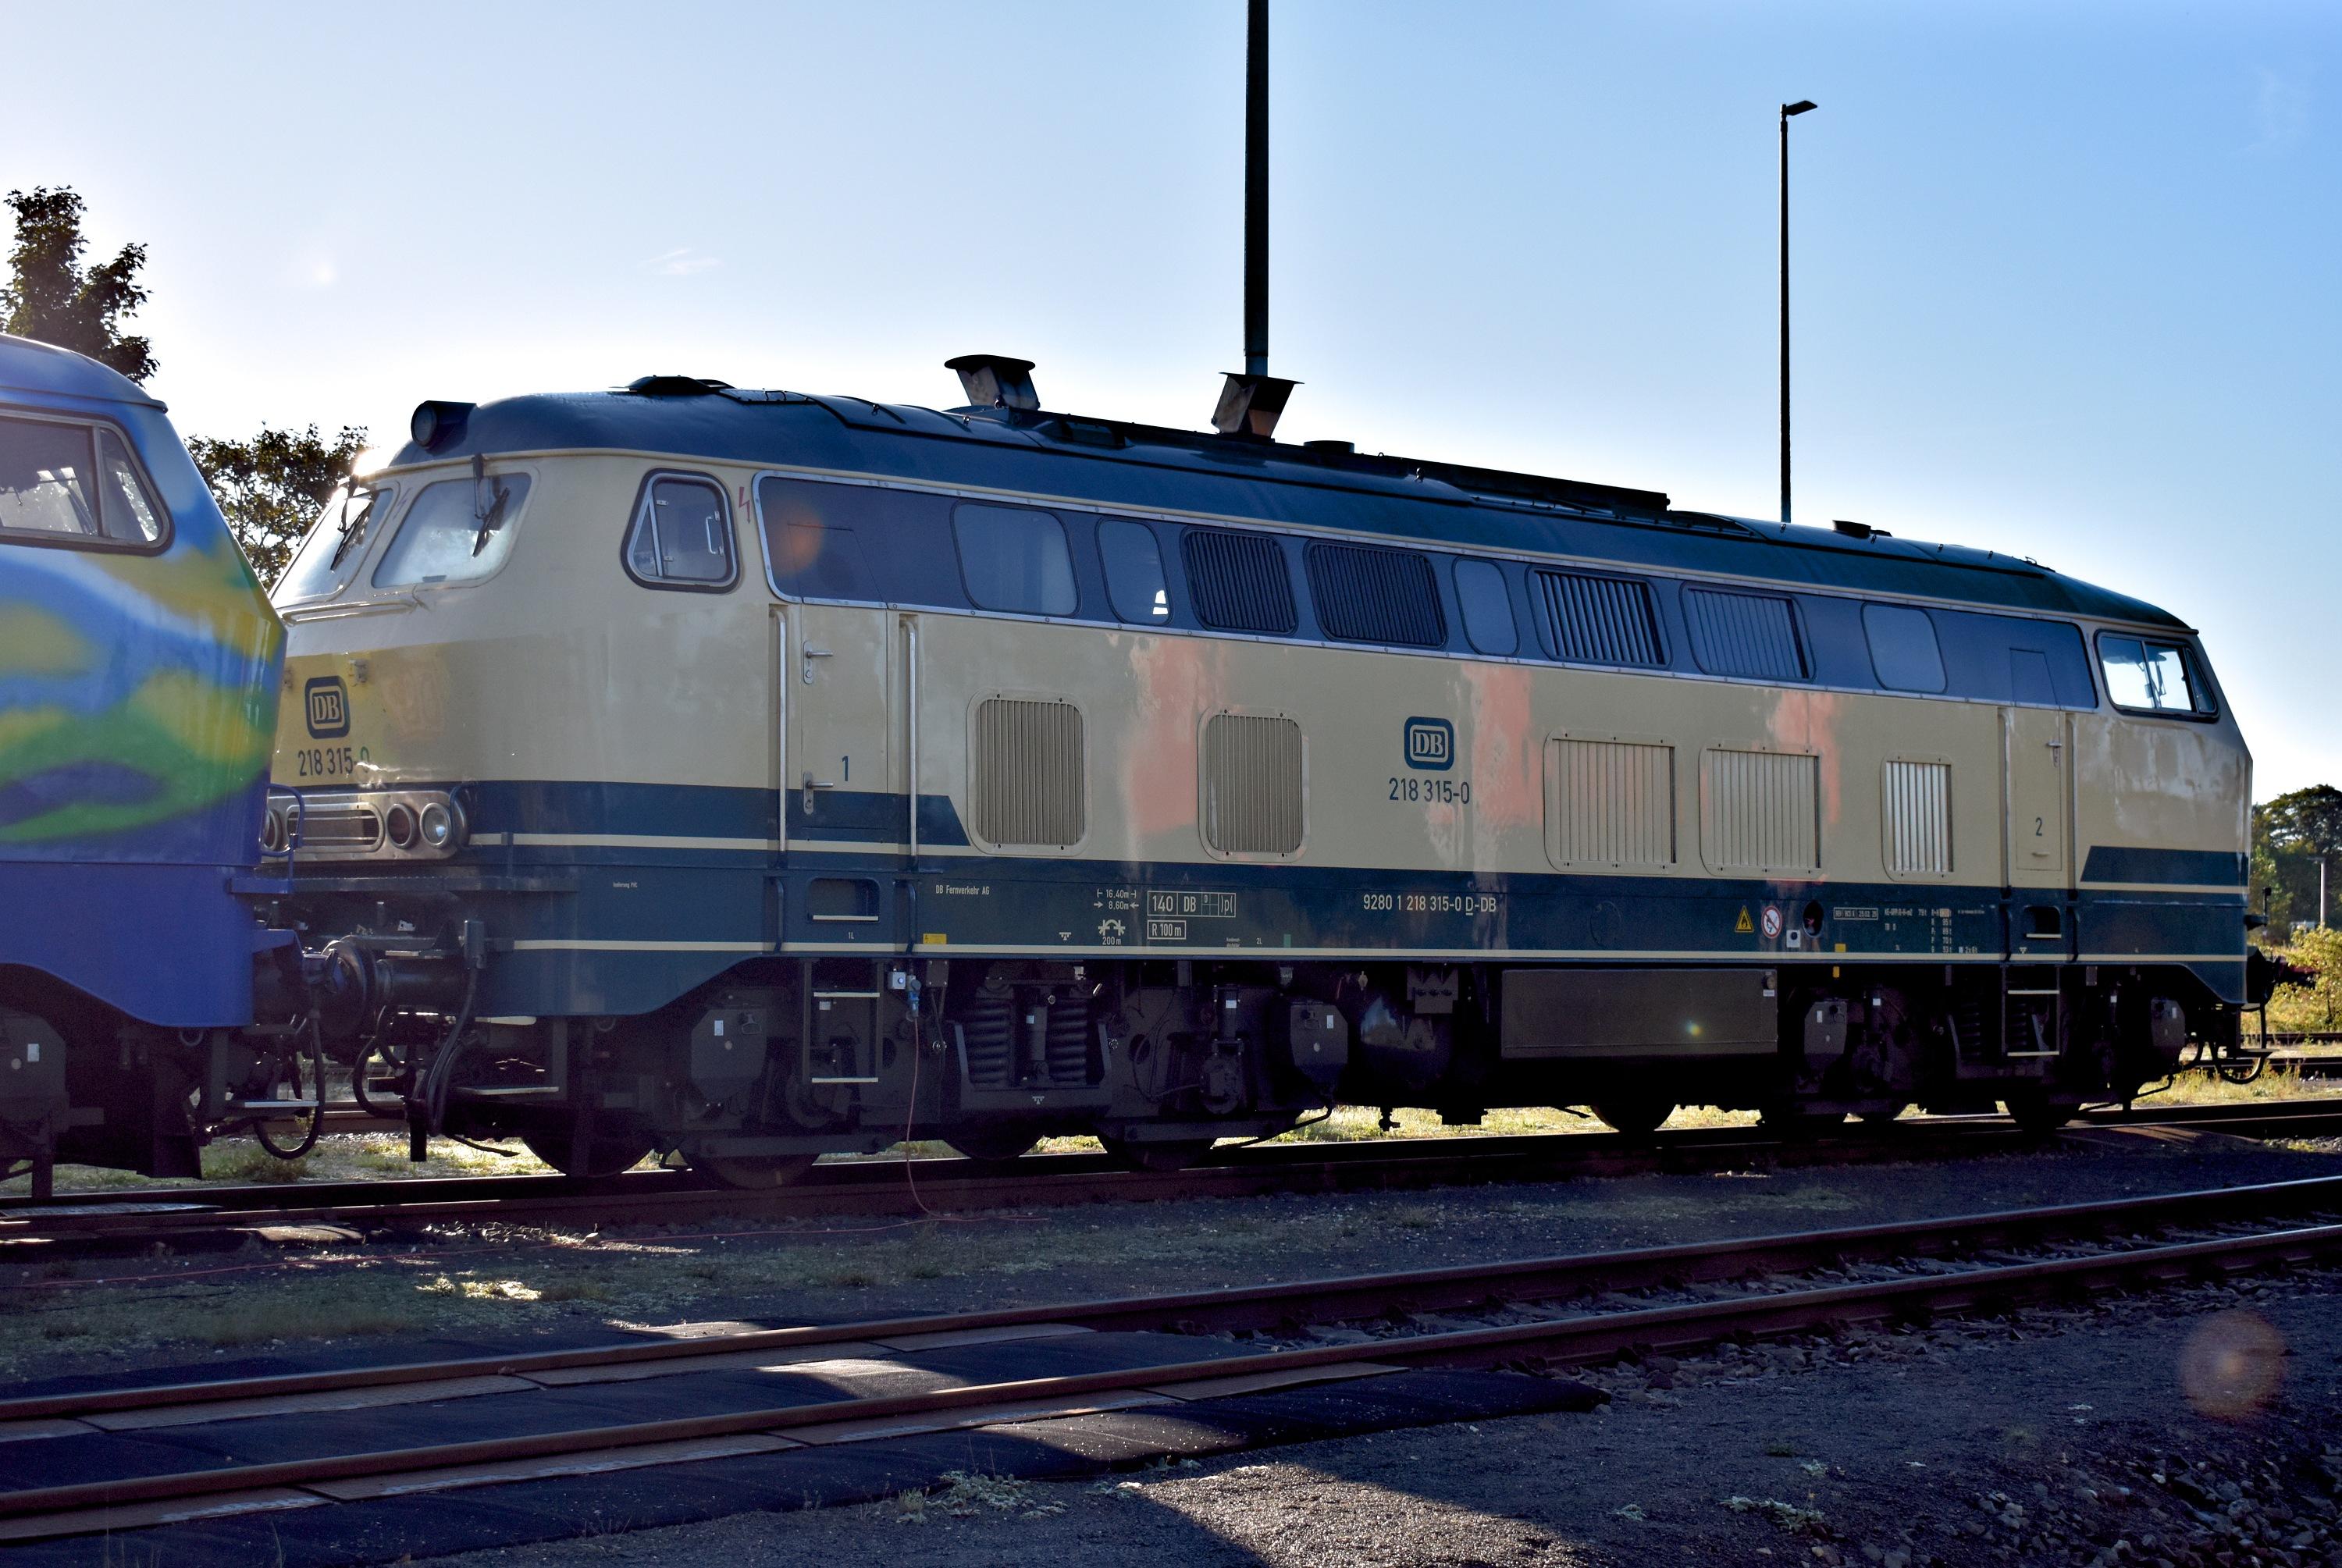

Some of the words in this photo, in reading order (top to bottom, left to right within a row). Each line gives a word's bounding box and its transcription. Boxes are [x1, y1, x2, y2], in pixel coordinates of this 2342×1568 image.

[313, 695, 340, 721] DB
[1414, 731, 1443, 756] DB
[298, 748, 323, 777] 218
[842, 756, 849, 781] 1
[1389, 777, 1418, 802] 218
[1423, 779, 1470, 805] 315-0
[2035, 816, 2043, 837] 2
[935, 884, 944, 894] DB
[945, 884, 980, 895] Fernverkehr
[981, 886, 990, 895] AG
[1105, 889, 1130, 899] 16.40m
[1108, 901, 1130, 910] 8.60m
[1152, 894, 1173, 912] 140
[1183, 895, 1197, 912] DB
[1363, 894, 1393, 911] 9280
[1397, 894, 1402, 911] 1
[1406, 895, 1426, 912] 218
[1429, 895, 1462, 912] 315-0
[1465, 896, 1497, 916] D-DB
[1151, 923, 1158, 937] R
